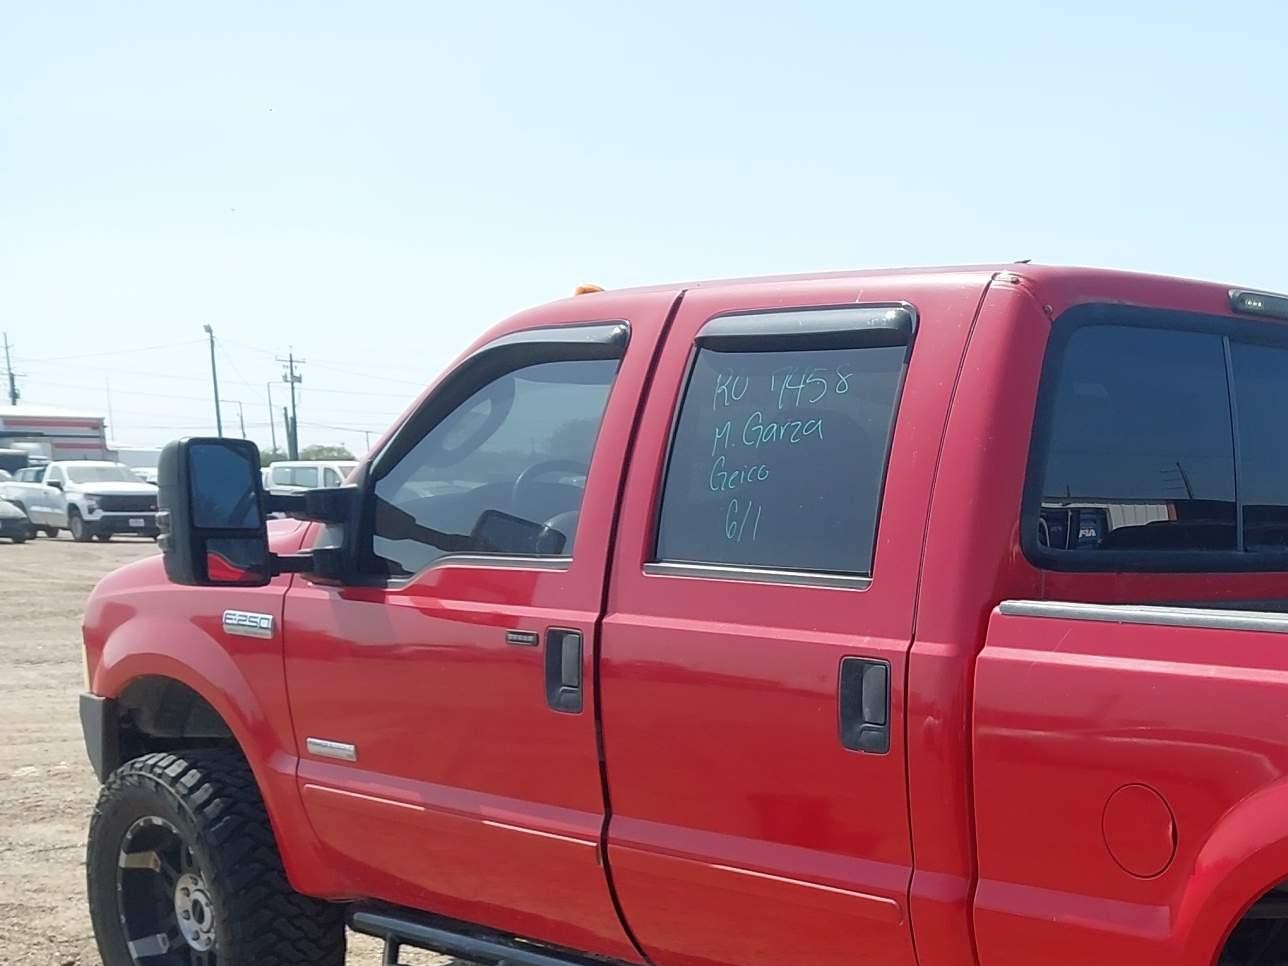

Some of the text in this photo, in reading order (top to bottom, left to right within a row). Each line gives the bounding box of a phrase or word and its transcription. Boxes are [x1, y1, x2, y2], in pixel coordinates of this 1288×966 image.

[742, 410, 824, 449] Garza
[709, 455, 770, 491] Geico
[724, 498, 762, 542] 6/1
